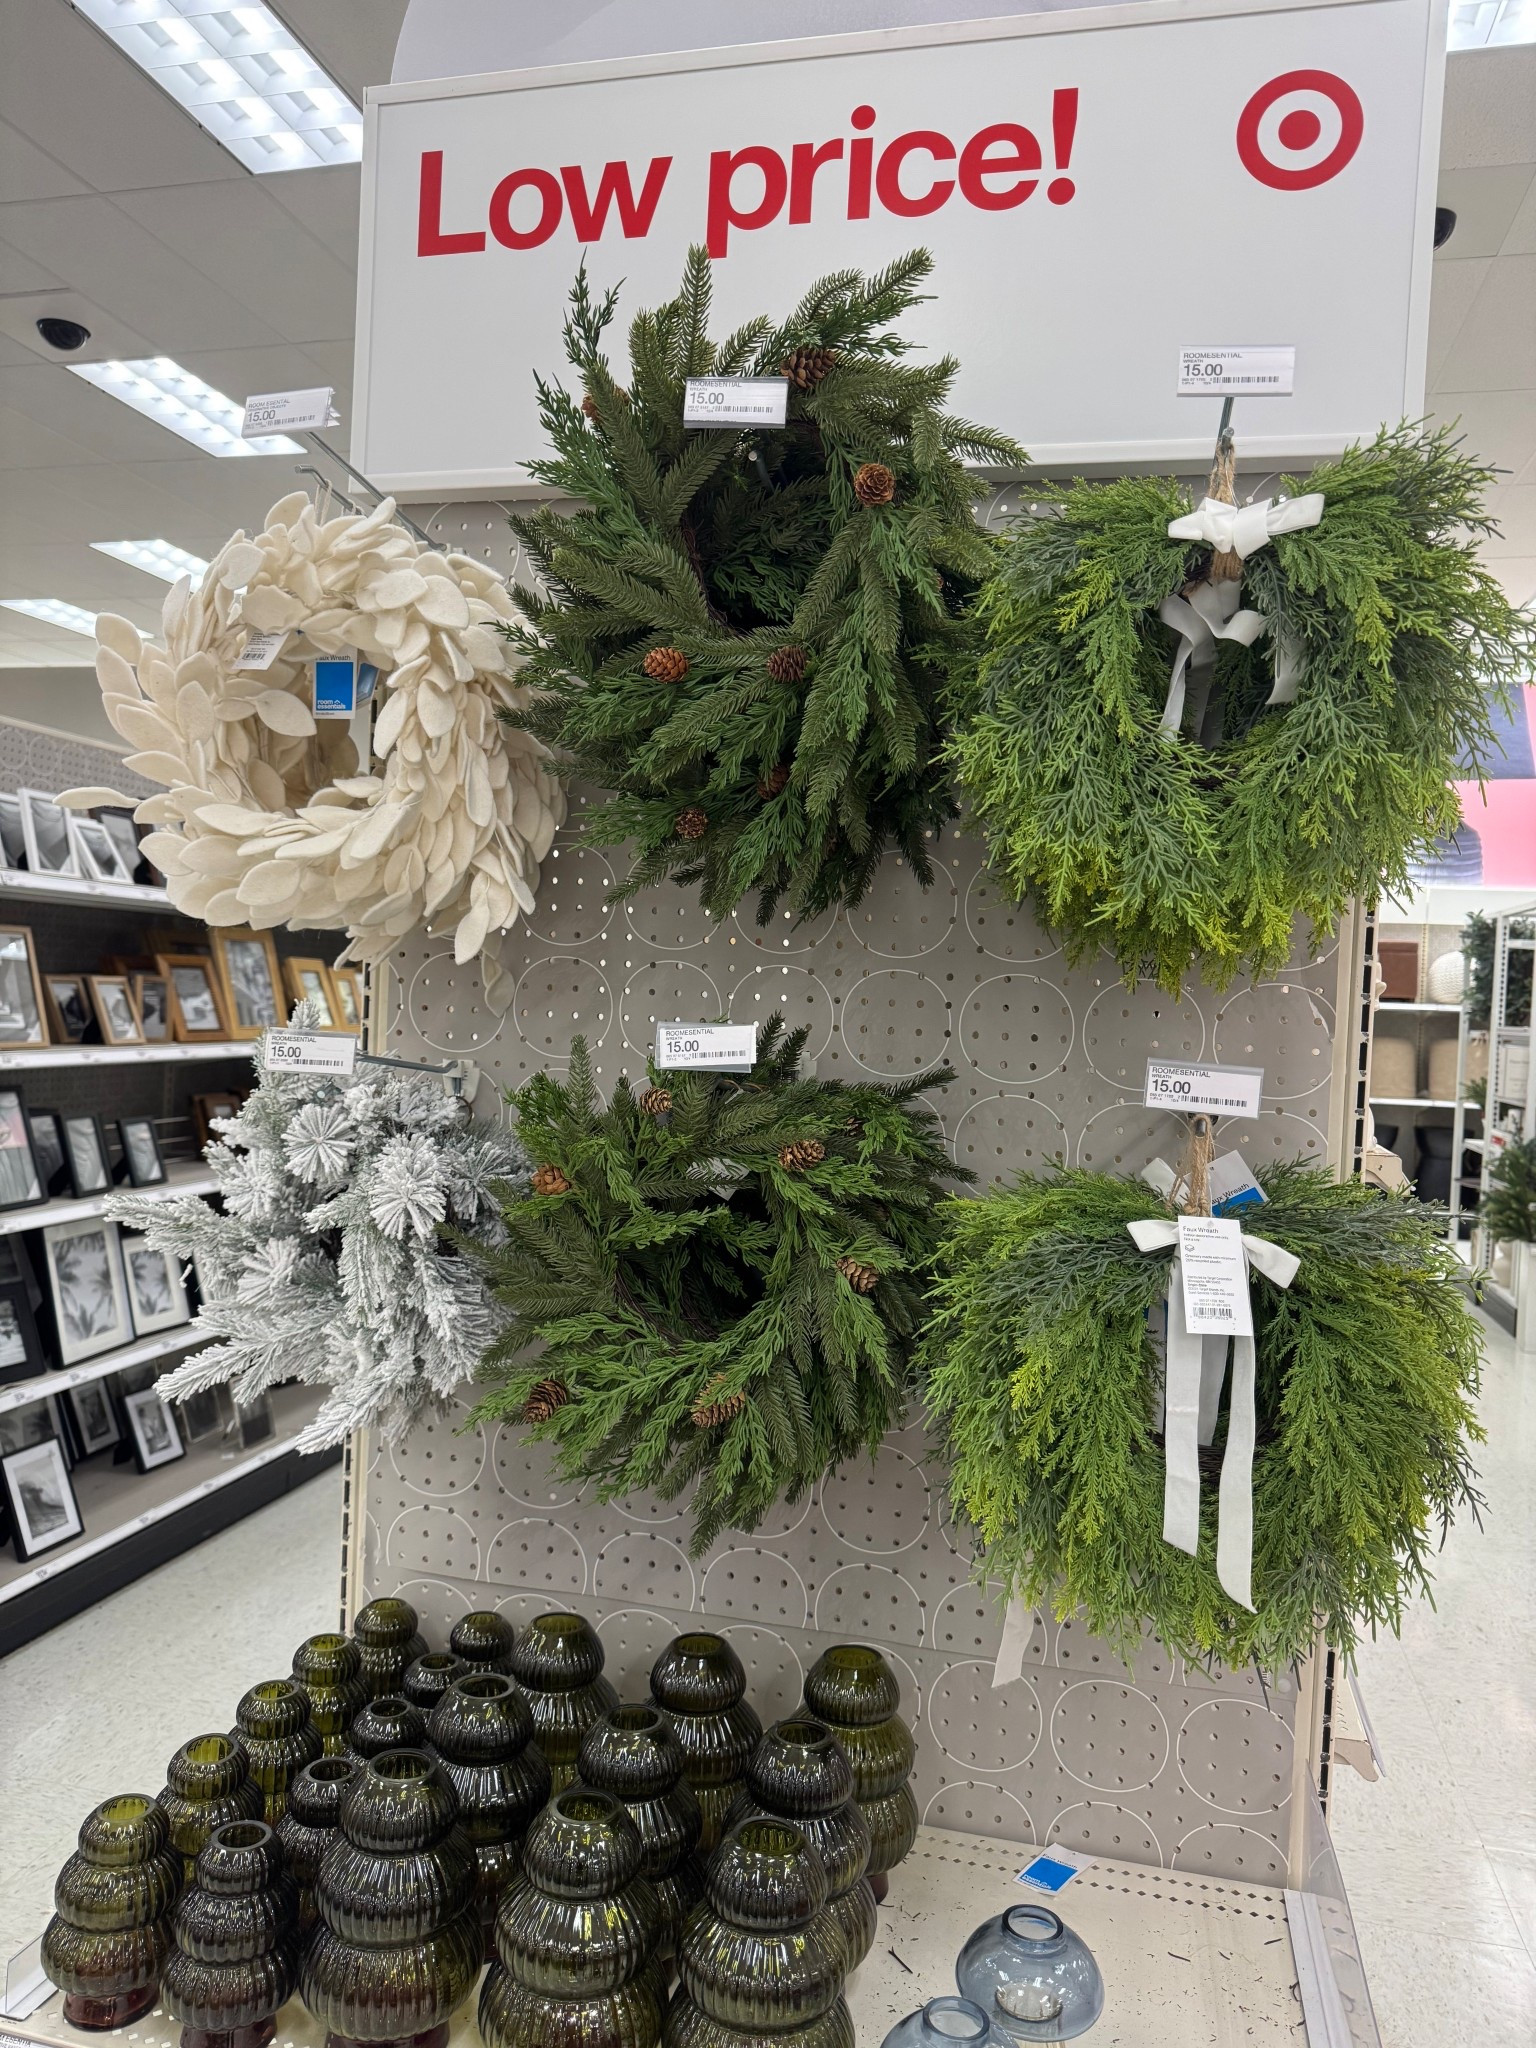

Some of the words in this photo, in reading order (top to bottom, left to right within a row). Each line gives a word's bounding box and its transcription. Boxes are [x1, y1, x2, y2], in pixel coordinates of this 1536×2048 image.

[417, 150, 673, 257] Low
[706, 87, 1079, 260] price!
[1184, 364, 1223, 376] 15.00
[690, 392, 724, 404] 15.00
[248, 409, 276, 422] 15.00
[665, 1028, 714, 1036] ROOMESENTIAL
[271, 1035, 316, 1043] ROOMESENTIAL
[271, 1046, 301, 1058] 15.00
[667, 1040, 699, 1053] 15.00
[1152, 1066, 1211, 1078] ROOMESENTIAL
[1152, 1079, 1191, 1094] 15.00
[1222, 1183, 1250, 1198] Wreath
